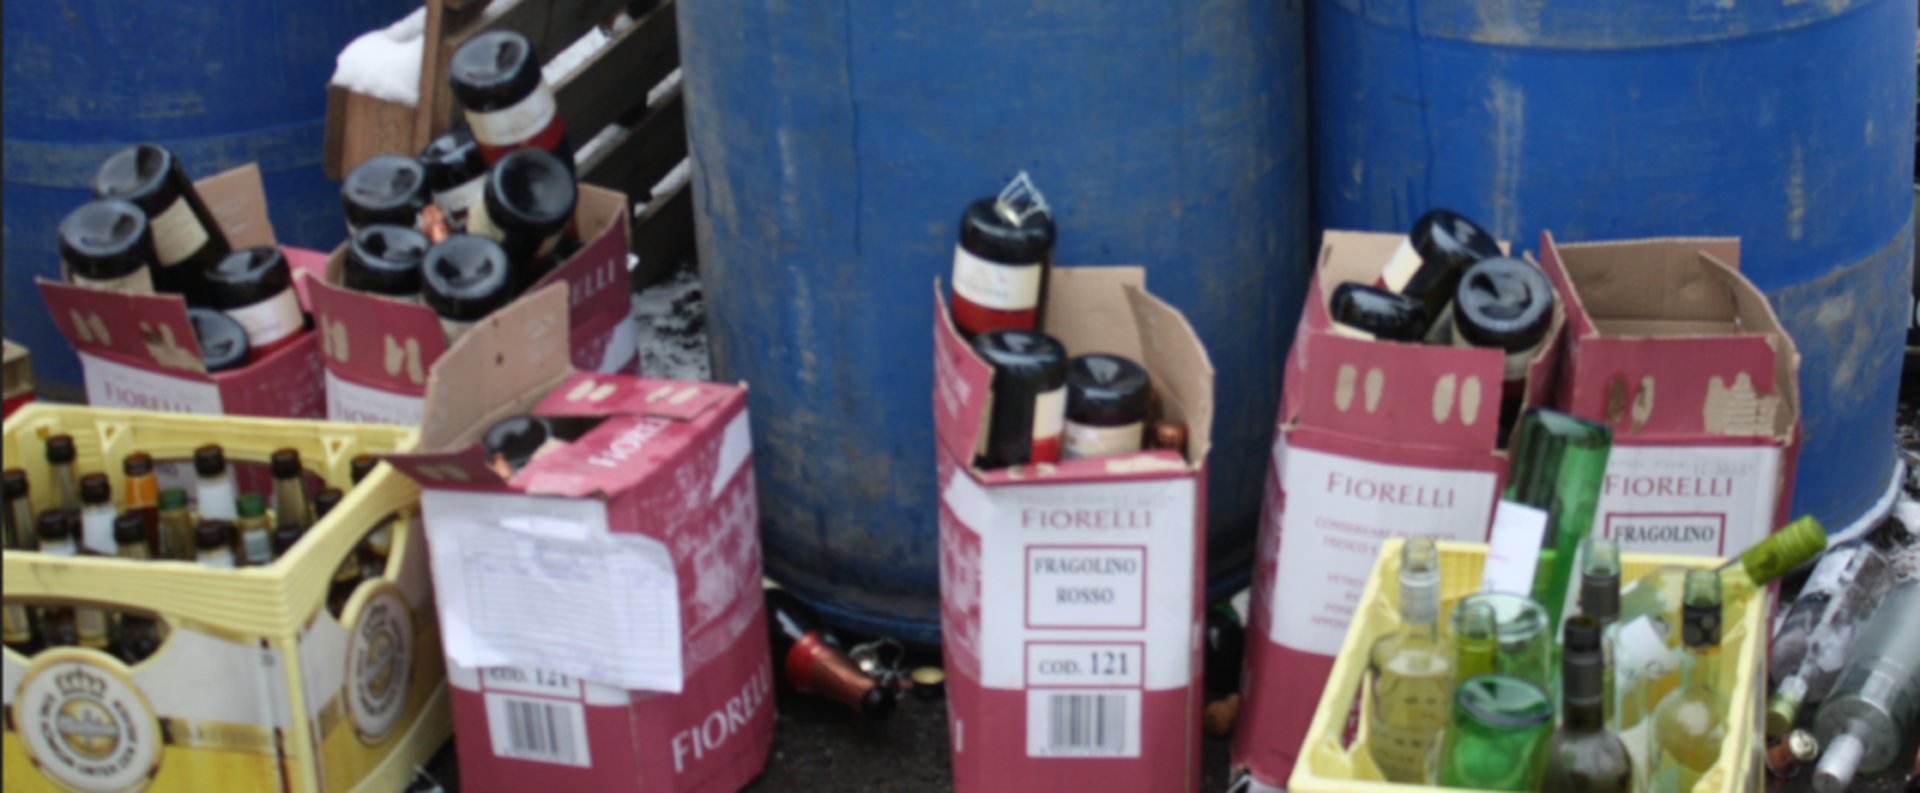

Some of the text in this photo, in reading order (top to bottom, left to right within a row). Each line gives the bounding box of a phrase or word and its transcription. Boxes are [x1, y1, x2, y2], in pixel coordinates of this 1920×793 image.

[1326, 471, 1456, 509] FIORELLI
[1604, 475, 1733, 497] FIORELLI
[1020, 508, 1152, 530] FIORELLI
[1614, 525, 1716, 544] FRAGOLINO
[1033, 556, 1137, 575] FRAGOLINO
[1055, 587, 1115, 604] ROSSO
[1090, 651, 1128, 675] 121
